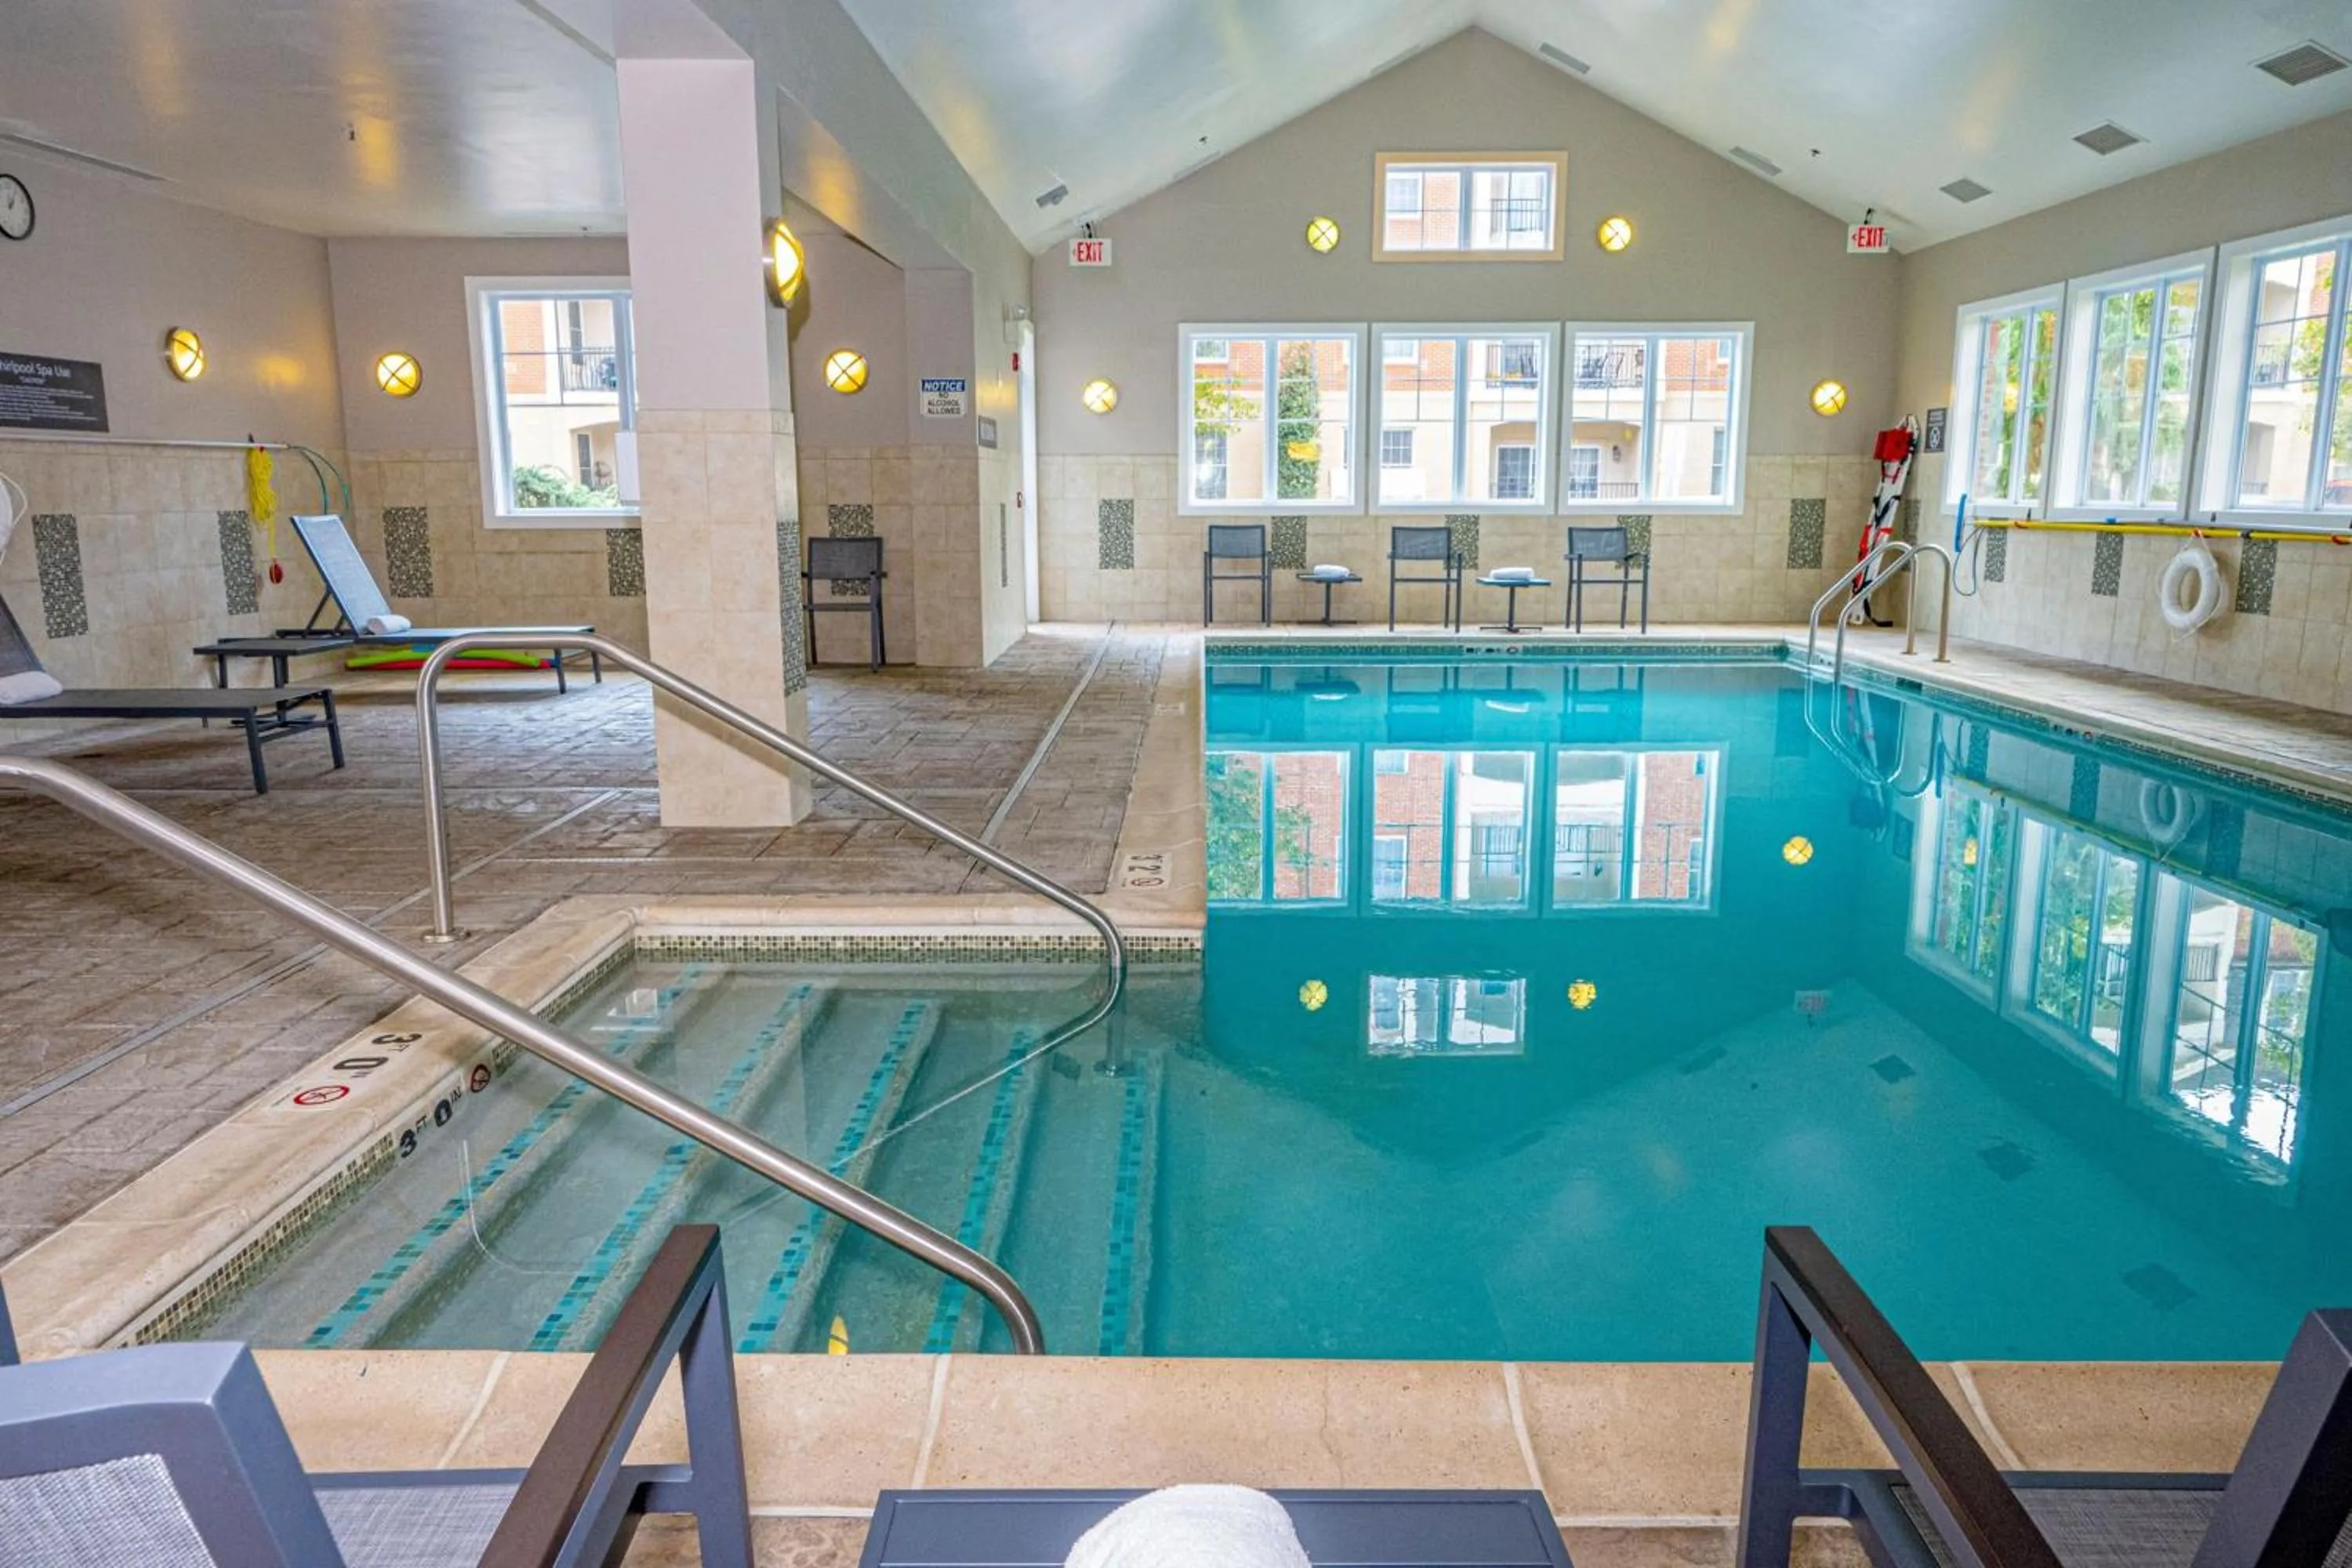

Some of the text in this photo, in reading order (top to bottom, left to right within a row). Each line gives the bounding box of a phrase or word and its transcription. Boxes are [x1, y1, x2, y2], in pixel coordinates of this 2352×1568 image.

[1857, 227, 1885, 248] EXIT
[1077, 241, 1104, 262] EXIT
[37, 364, 53, 377] Spa
[924, 381, 963, 391] NOTICE
[372, 1033, 423, 1045] 3
[400, 1129, 418, 1158] 3
[416, 1114, 427, 1133] FT
[434, 1098, 452, 1127] 0
